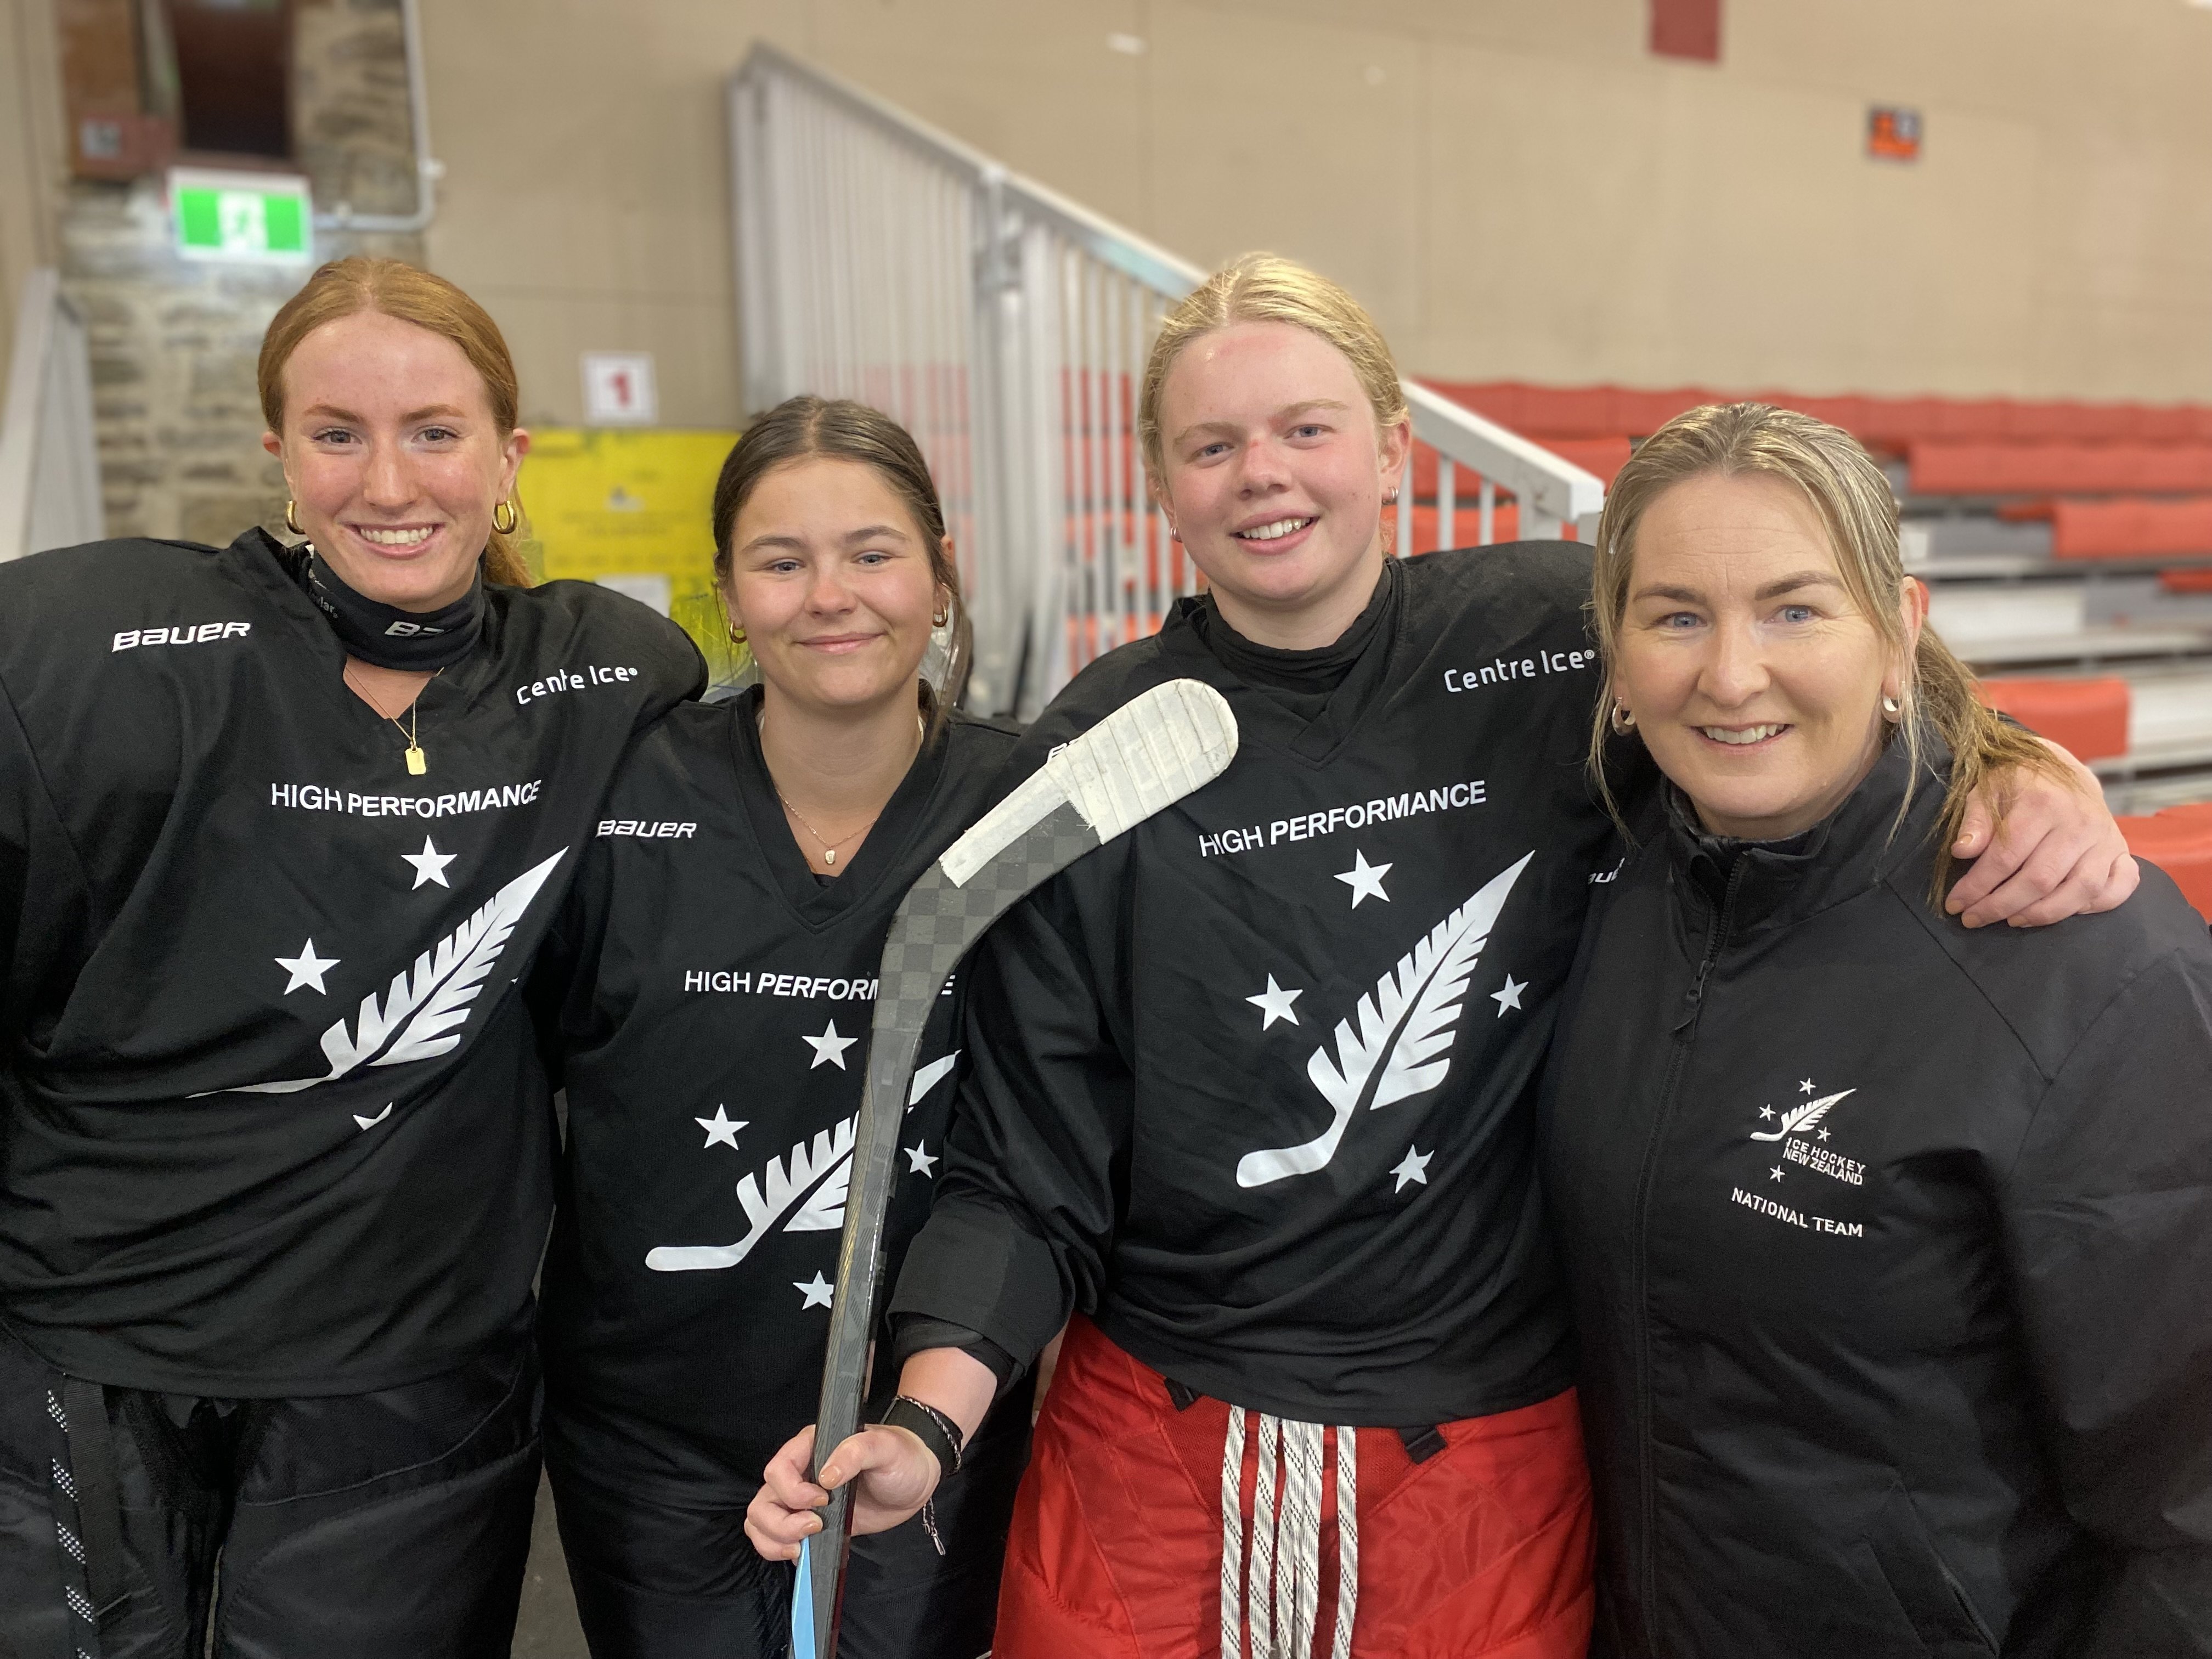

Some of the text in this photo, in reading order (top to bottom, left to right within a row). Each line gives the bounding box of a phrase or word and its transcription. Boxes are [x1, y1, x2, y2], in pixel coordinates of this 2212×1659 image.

[111, 622, 251, 653] BAUER
[1444, 658, 1536, 692] Centre
[271, 779, 541, 819] HIGH PERFORMANCE
[595, 819, 697, 838] BAUER
[1199, 780, 1487, 857] HIGH PERFORMANCE
[684, 970, 751, 993] HIGH
[1782, 1147, 1863, 1186] NEW ZEALAND
[1786, 1137, 1866, 1175] ICE HOCKEY
[1731, 1187, 1863, 1238] NATIONAL TEAM
